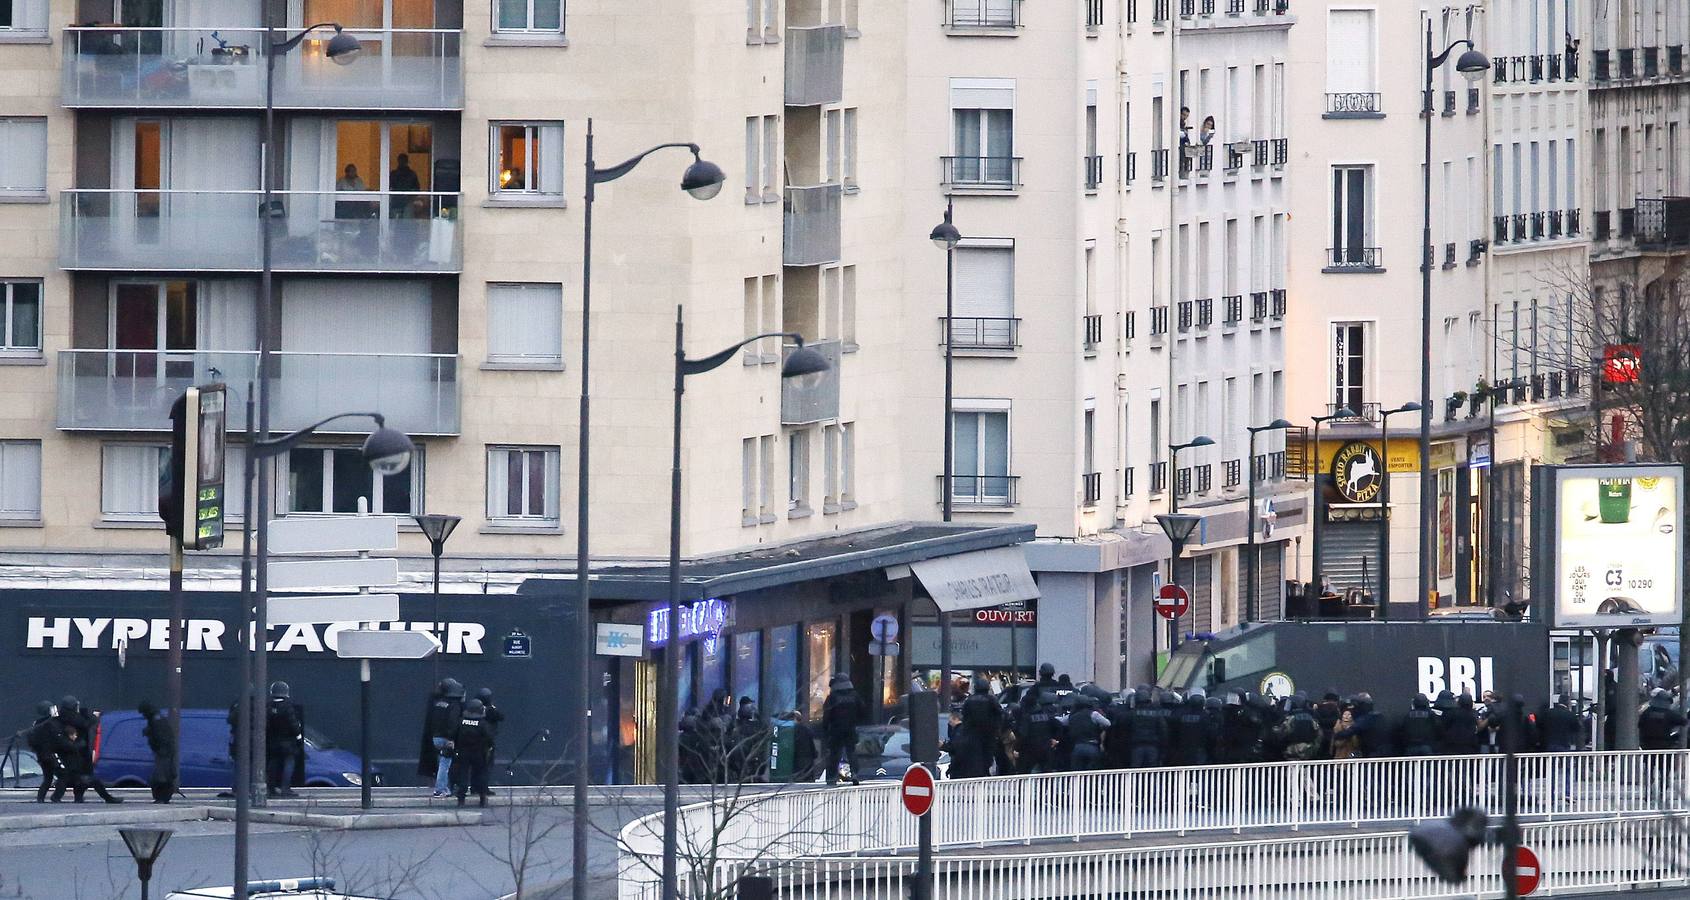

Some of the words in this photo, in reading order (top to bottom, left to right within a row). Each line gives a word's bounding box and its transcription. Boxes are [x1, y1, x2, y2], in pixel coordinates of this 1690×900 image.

[1341, 445, 1366, 460] RABBIT
[1336, 462, 1347, 488] SPEED
[1356, 483, 1379, 501] PIZZA
[1606, 570, 1622, 585] C3
[976, 610, 1034, 622] OUVERT
[27, 617, 226, 651] HYPER
[238, 620, 486, 654] CACR
[1418, 656, 1494, 702] BRI
